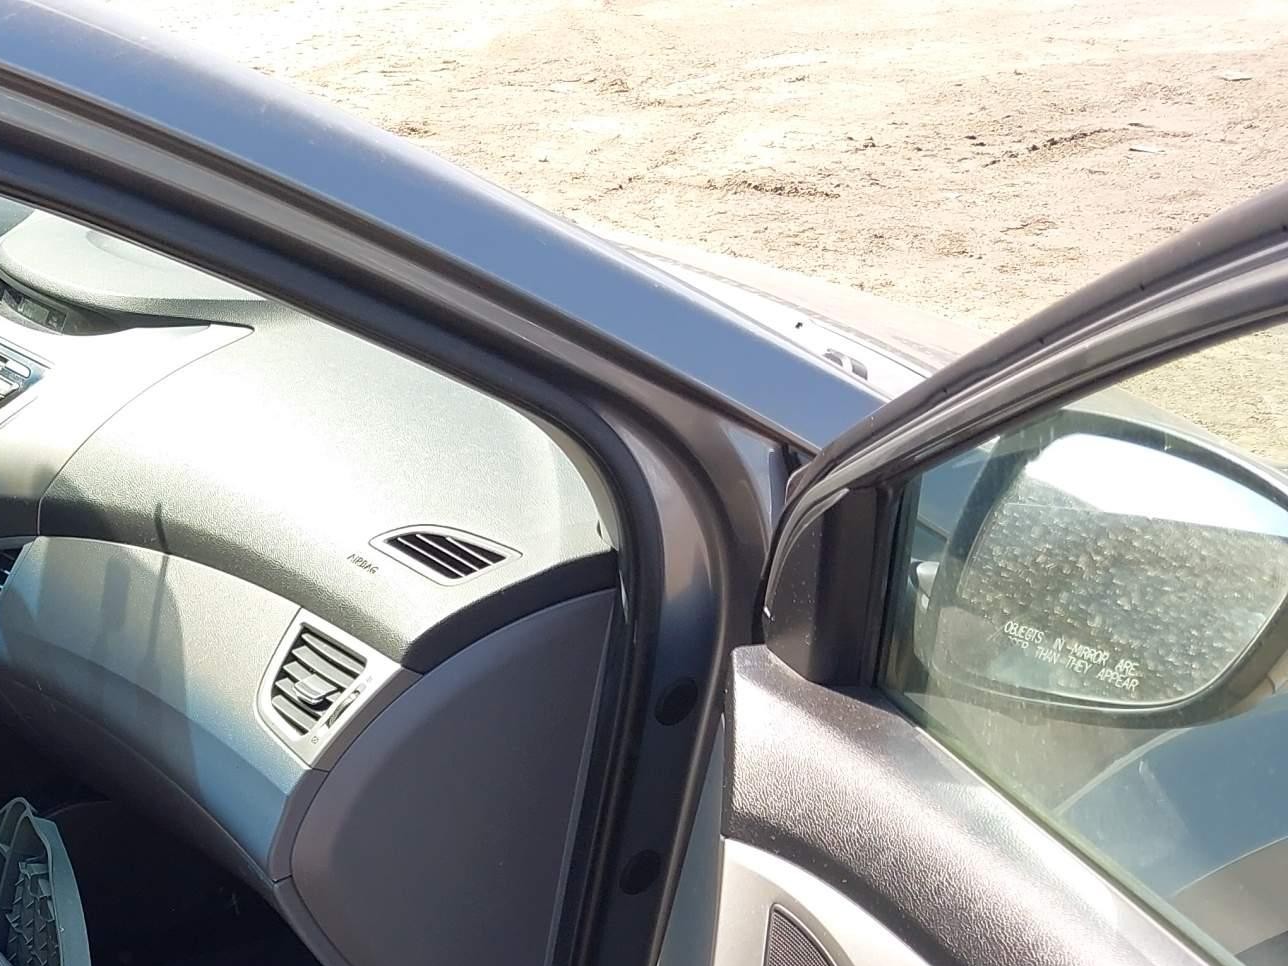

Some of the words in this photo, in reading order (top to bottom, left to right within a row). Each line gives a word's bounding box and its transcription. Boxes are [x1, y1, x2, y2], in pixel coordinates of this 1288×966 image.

[1003, 620, 1045, 644] OBJECTS
[1052, 635, 1065, 651] IN
[1069, 642, 1110, 666] MIRROR
[1114, 659, 1140, 677] ARE
[1034, 646, 1061, 665] THAN
[1064, 655, 1093, 674] THEY
[1095, 668, 1140, 692] APPEAR
